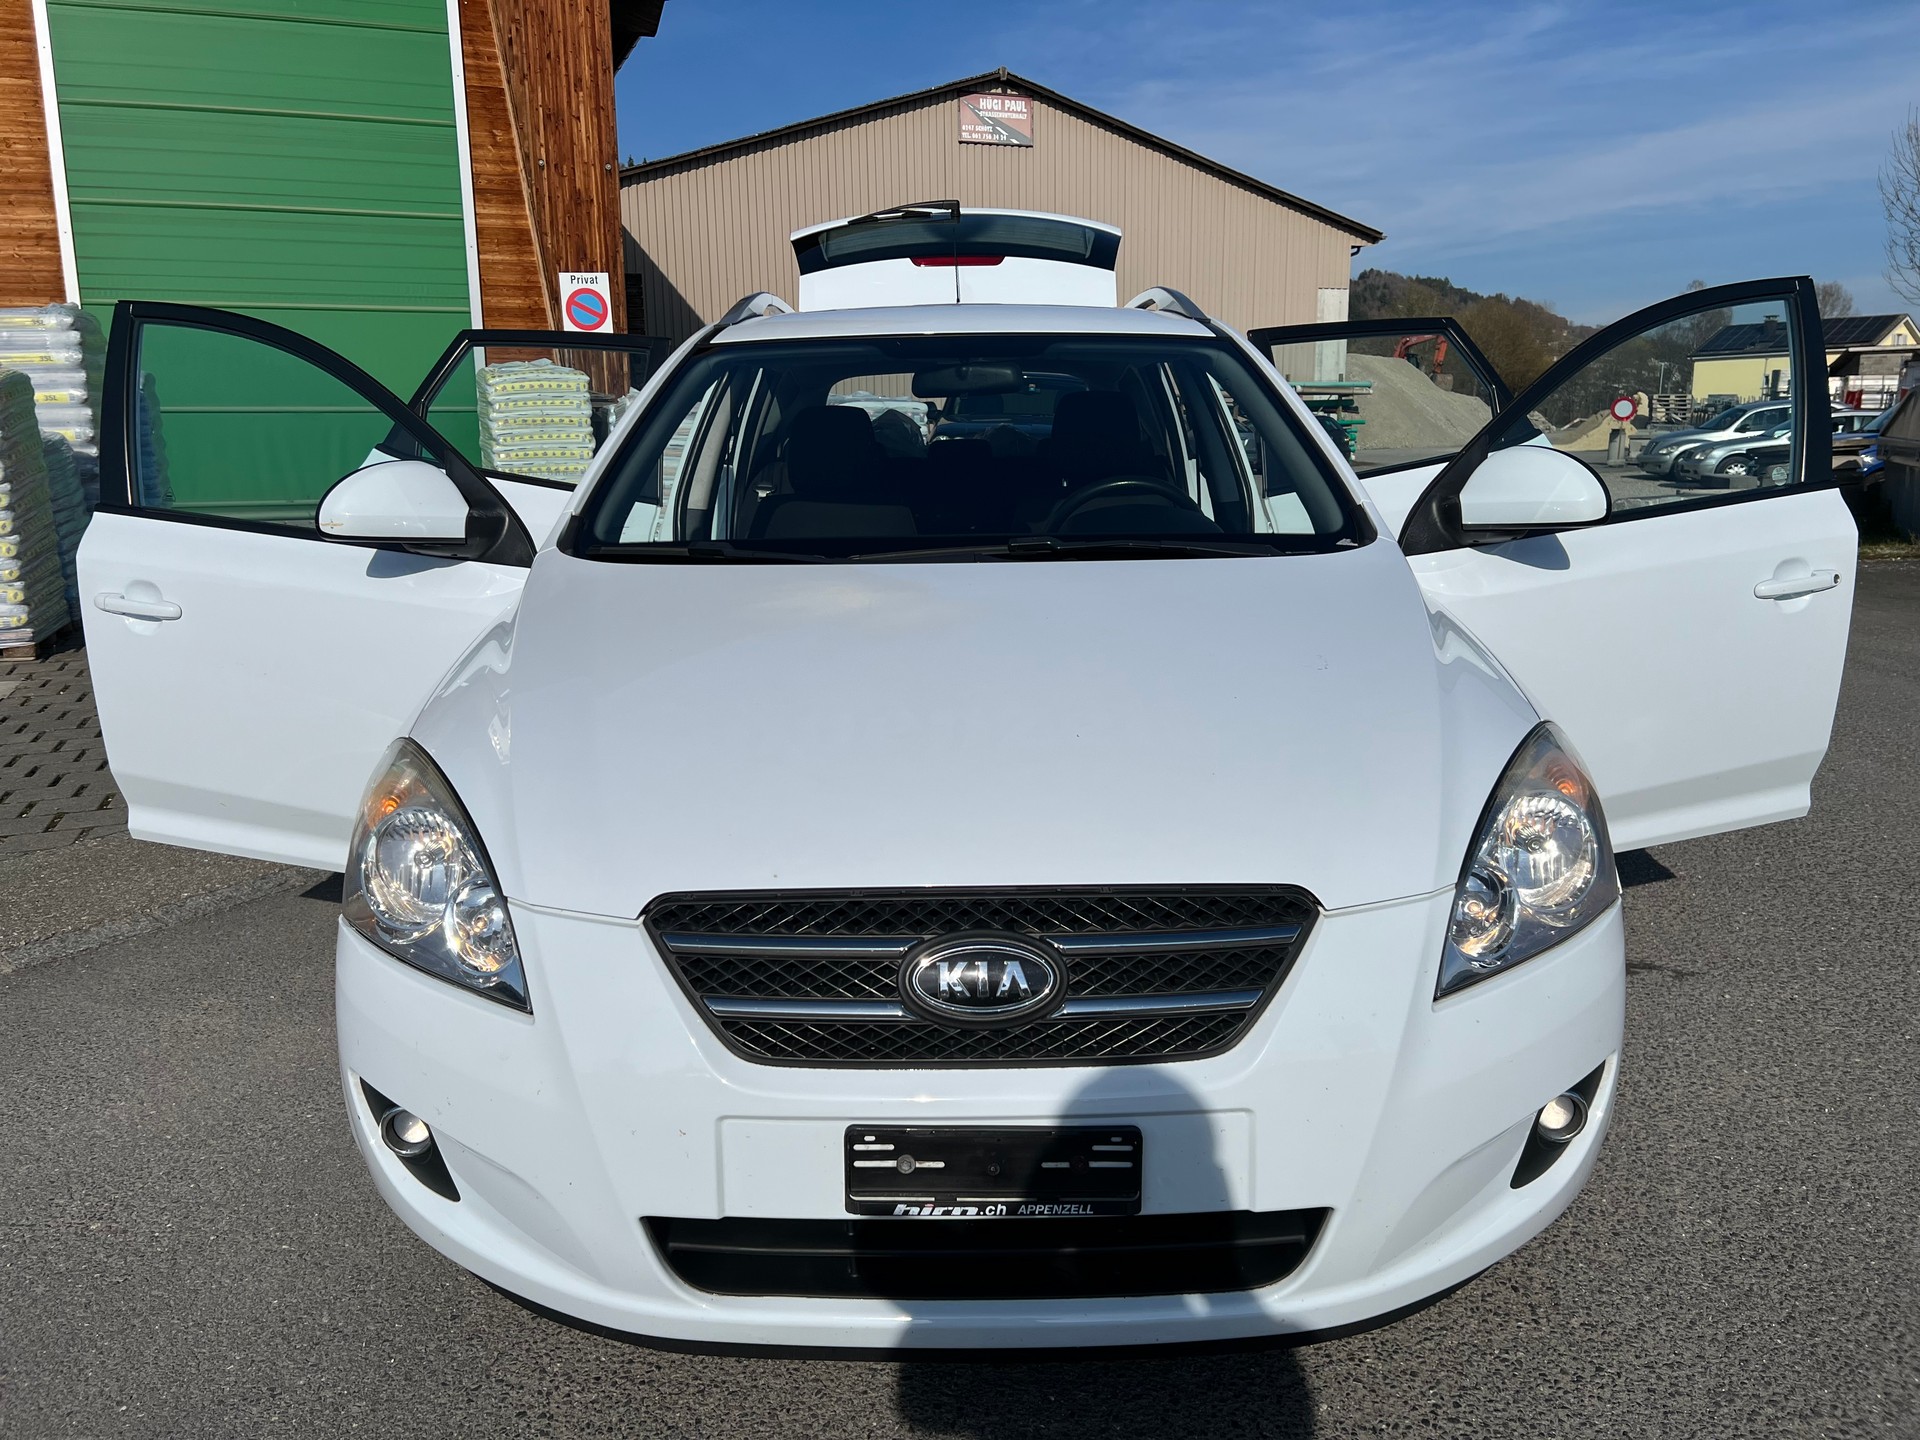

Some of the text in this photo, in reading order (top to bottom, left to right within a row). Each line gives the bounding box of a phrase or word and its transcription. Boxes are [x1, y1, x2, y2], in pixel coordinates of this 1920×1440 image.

[979, 97, 1027, 112] HÜGI PAUL
[570, 275, 598, 284] Privat
[936, 960, 1033, 998] KIA
[1017, 1203, 1094, 1215] APPENZELL
